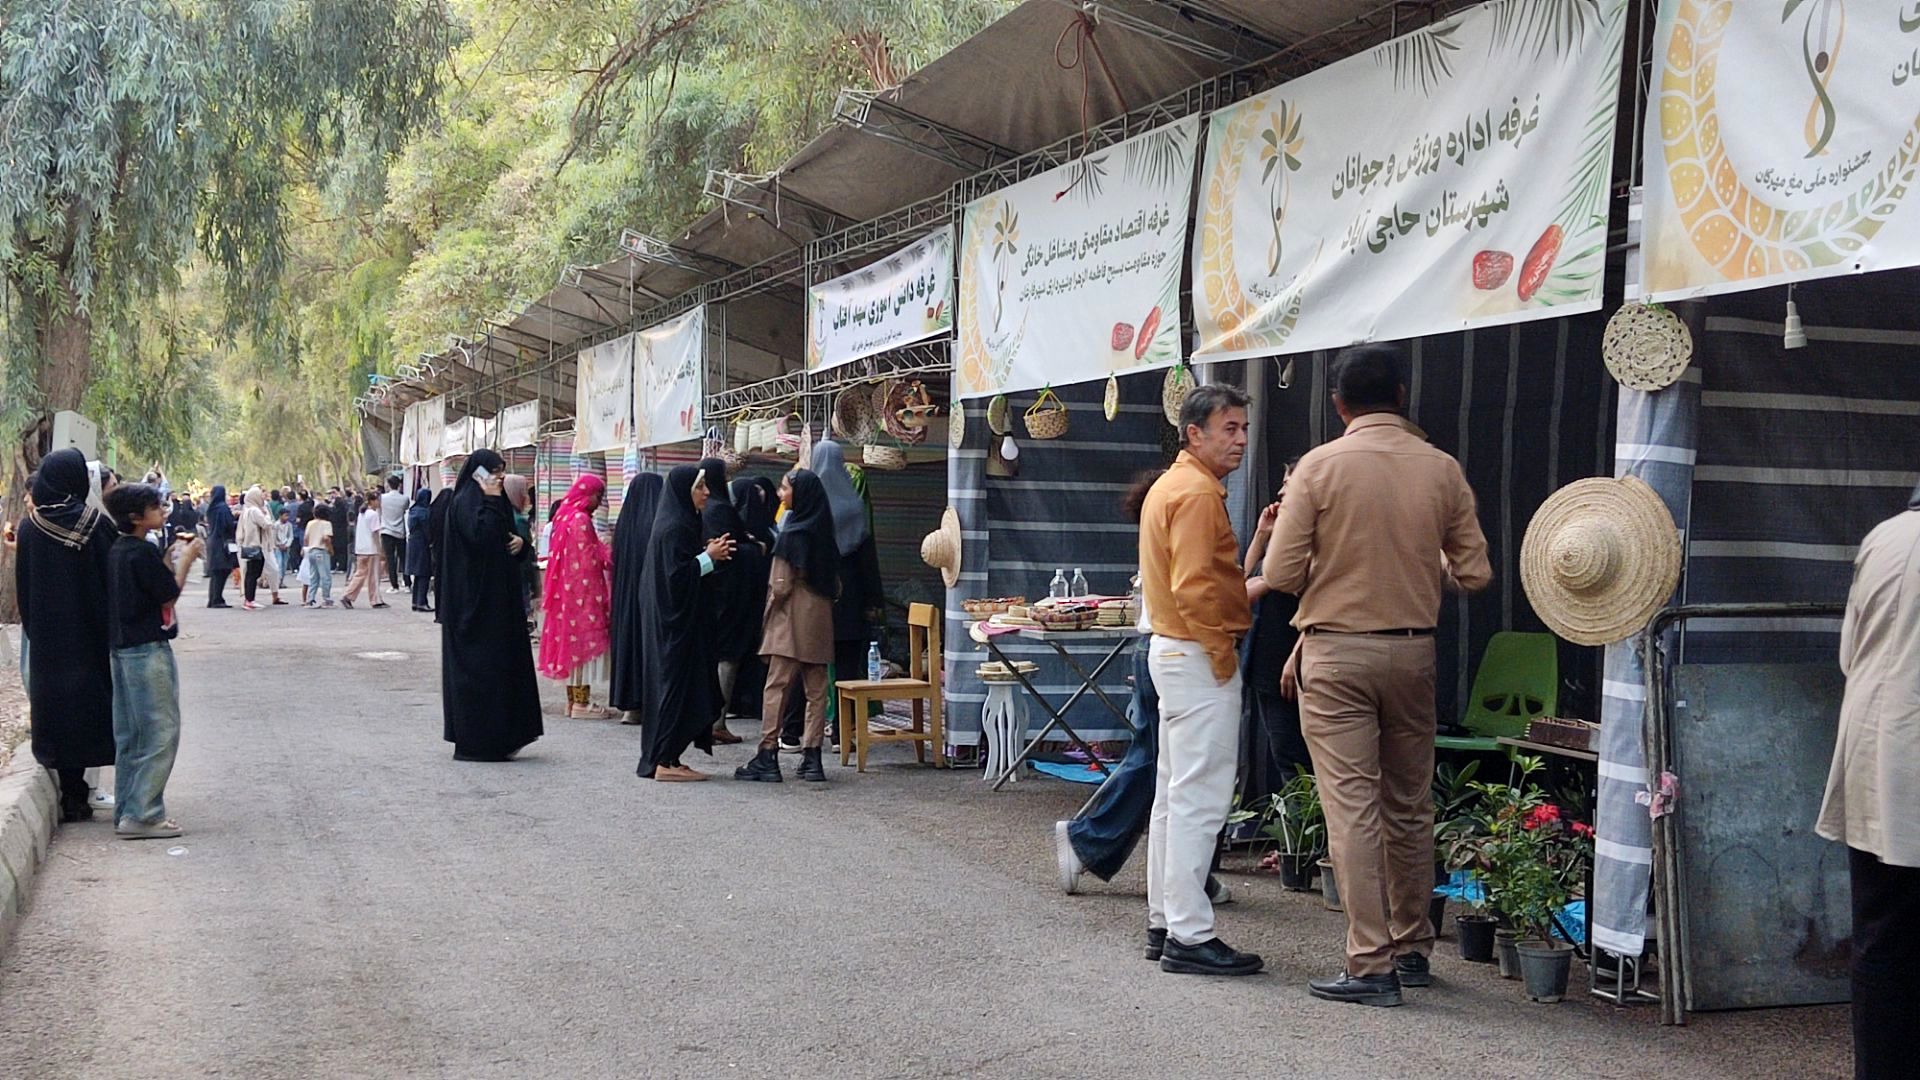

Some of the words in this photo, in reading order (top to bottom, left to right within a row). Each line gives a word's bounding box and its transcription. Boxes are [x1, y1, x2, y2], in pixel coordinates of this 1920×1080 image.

[1446, 108, 1491, 166] اداره
[1498, 93, 1540, 149] غرفه
[1332, 152, 1384, 200] جوانان
[1383, 153, 1396, 188] و
[1397, 132, 1441, 183] ورزش
[1828, 150, 1872, 187] جشنواره
[1114, 209, 1146, 242] اقتصاد
[1148, 202, 1169, 236] غرفه
[1367, 201, 1420, 254] حاجی
[1426, 178, 1509, 237] شهرستان
[1078, 224, 1113, 261] مقاومتی
[1341, 209, 1371, 254] آباد
[1021, 243, 1043, 276] خانگی
[916, 267, 935, 305] غرفه
